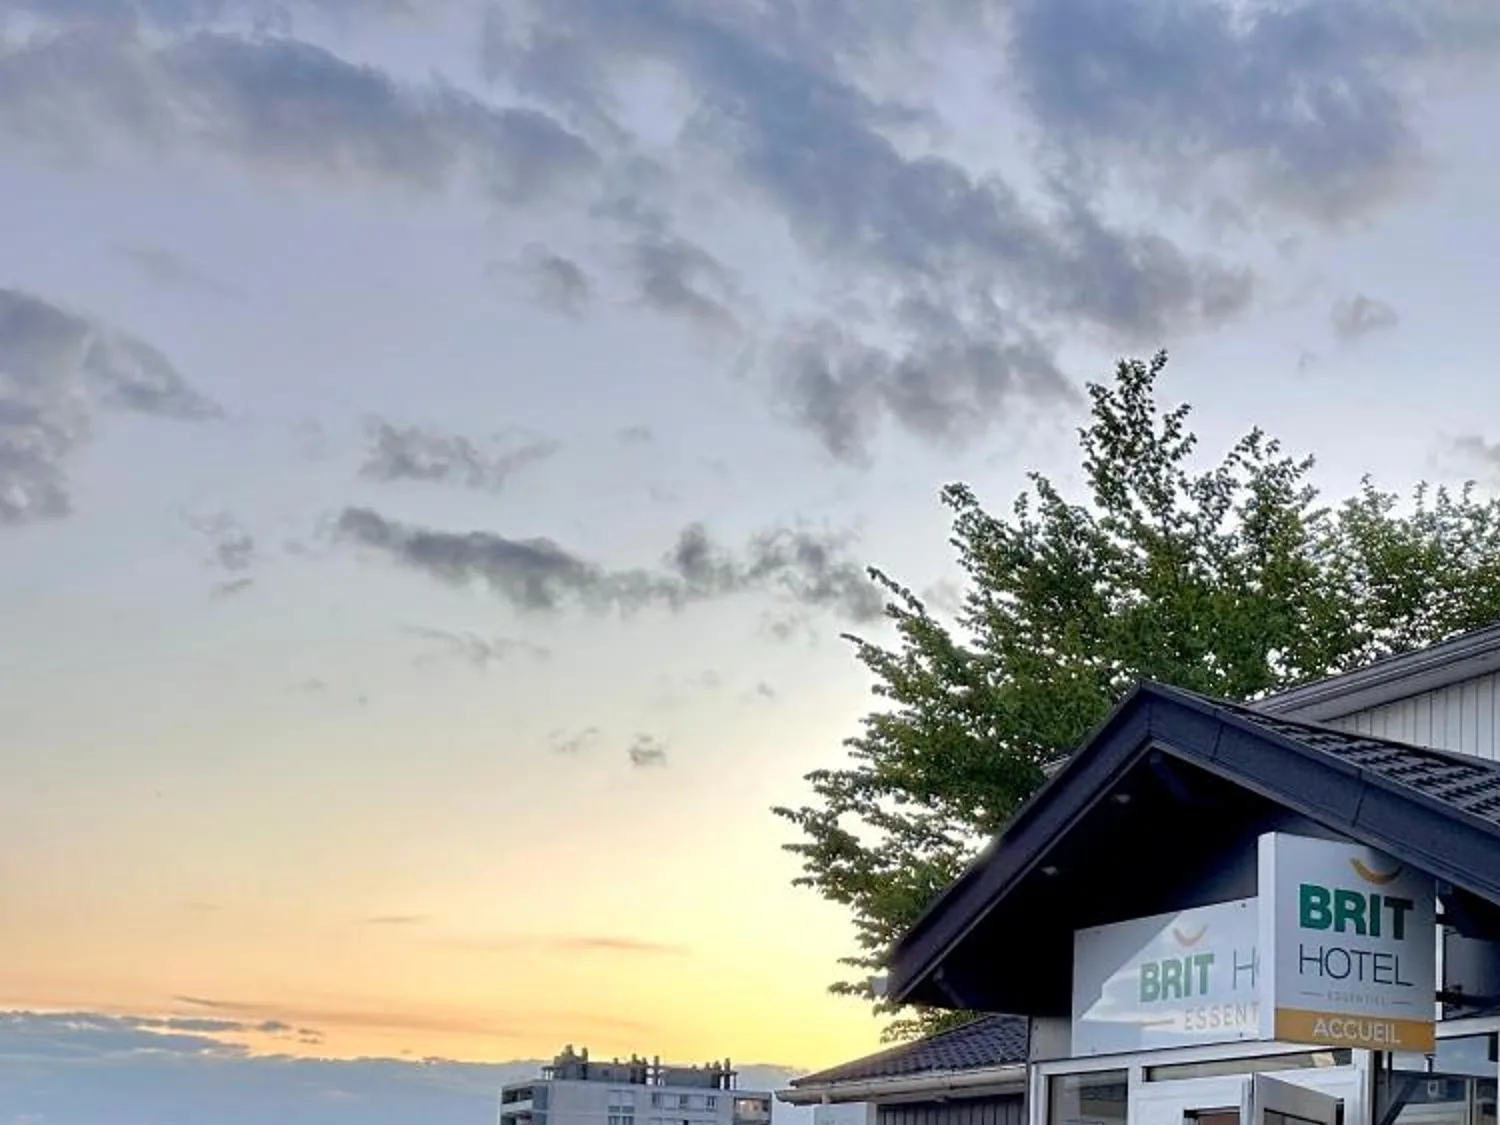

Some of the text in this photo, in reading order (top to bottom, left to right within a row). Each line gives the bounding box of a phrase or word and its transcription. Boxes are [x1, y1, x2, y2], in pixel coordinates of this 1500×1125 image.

[1299, 883, 1414, 941] BRIT
[1140, 946, 1260, 1002] BRIT H
[1299, 943, 1416, 988] HOTEL
[1312, 1018, 1401, 1044] ACCUEIL
